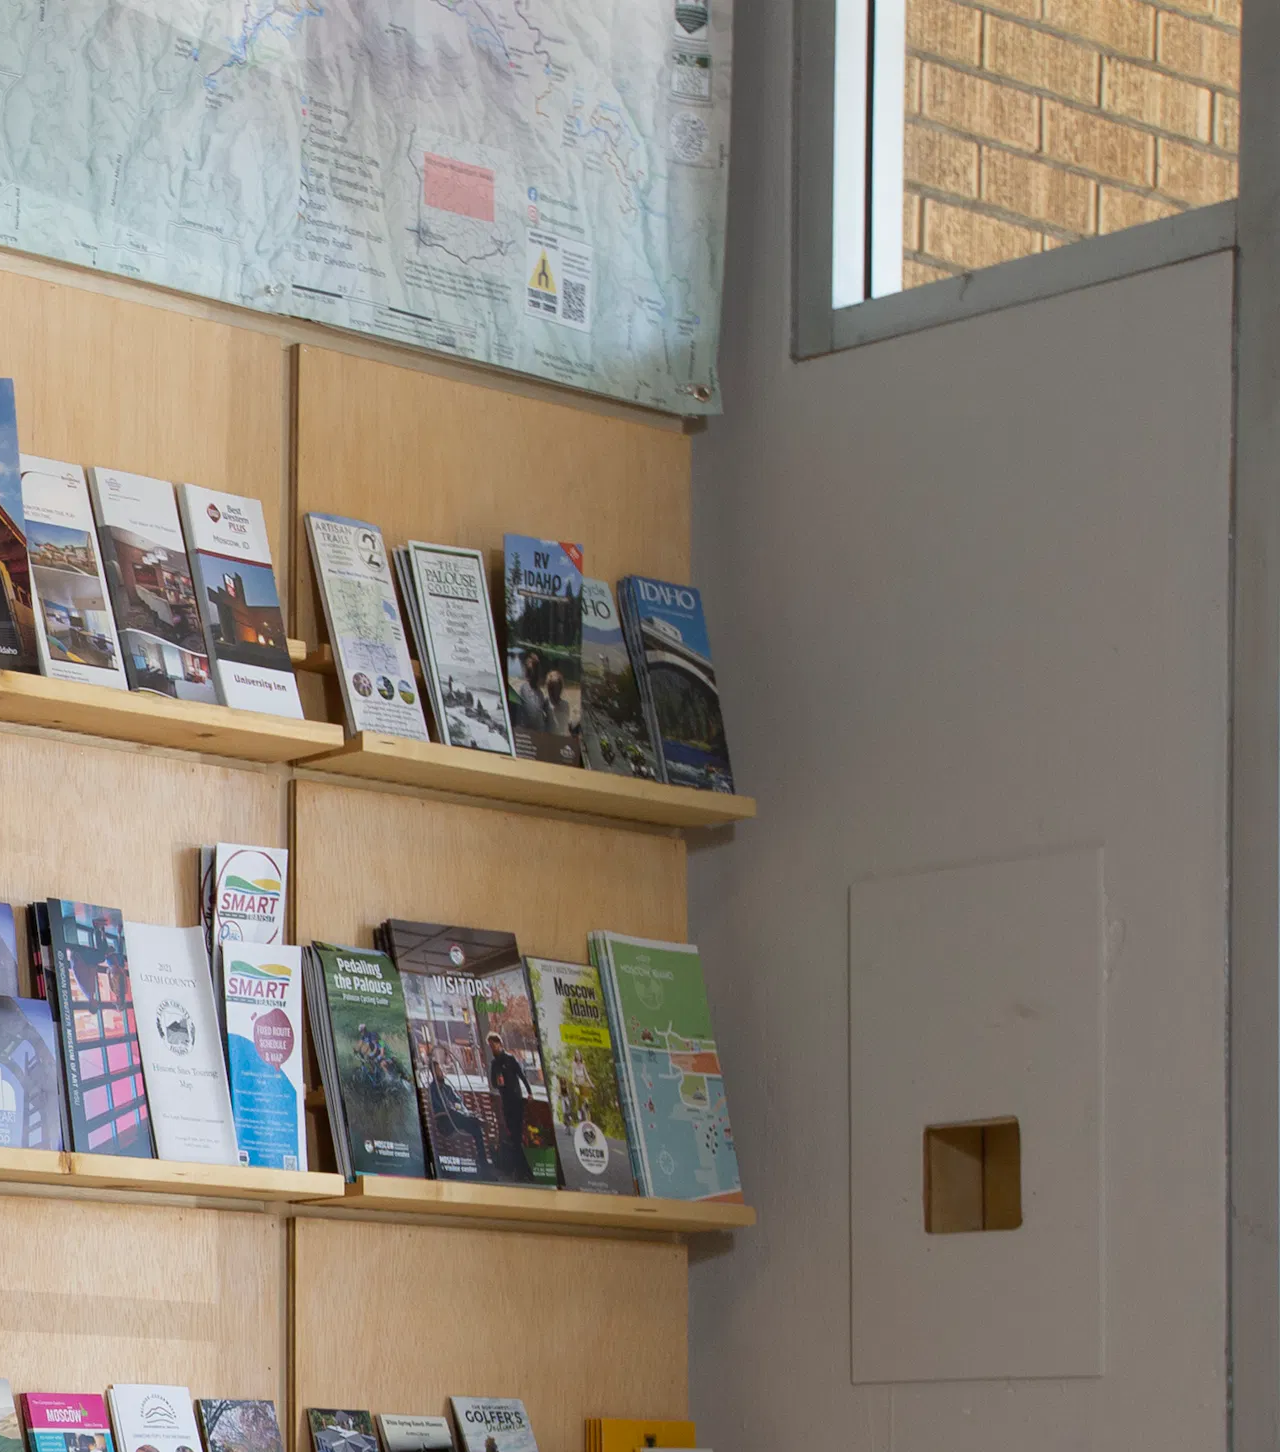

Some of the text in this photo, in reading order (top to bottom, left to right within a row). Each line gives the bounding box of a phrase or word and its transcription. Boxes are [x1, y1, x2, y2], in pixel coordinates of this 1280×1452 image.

[534, 550, 550, 570] RV
[425, 569, 477, 587] PALOUSE
[524, 568, 562, 592] IDAHO
[228, 979, 290, 999] SMART
[433, 974, 491, 998] VISITORS
[554, 977, 596, 1001] Moscow
[568, 998, 600, 1020] Idaho
[464, 1409, 524, 1426] GOLFER'S
